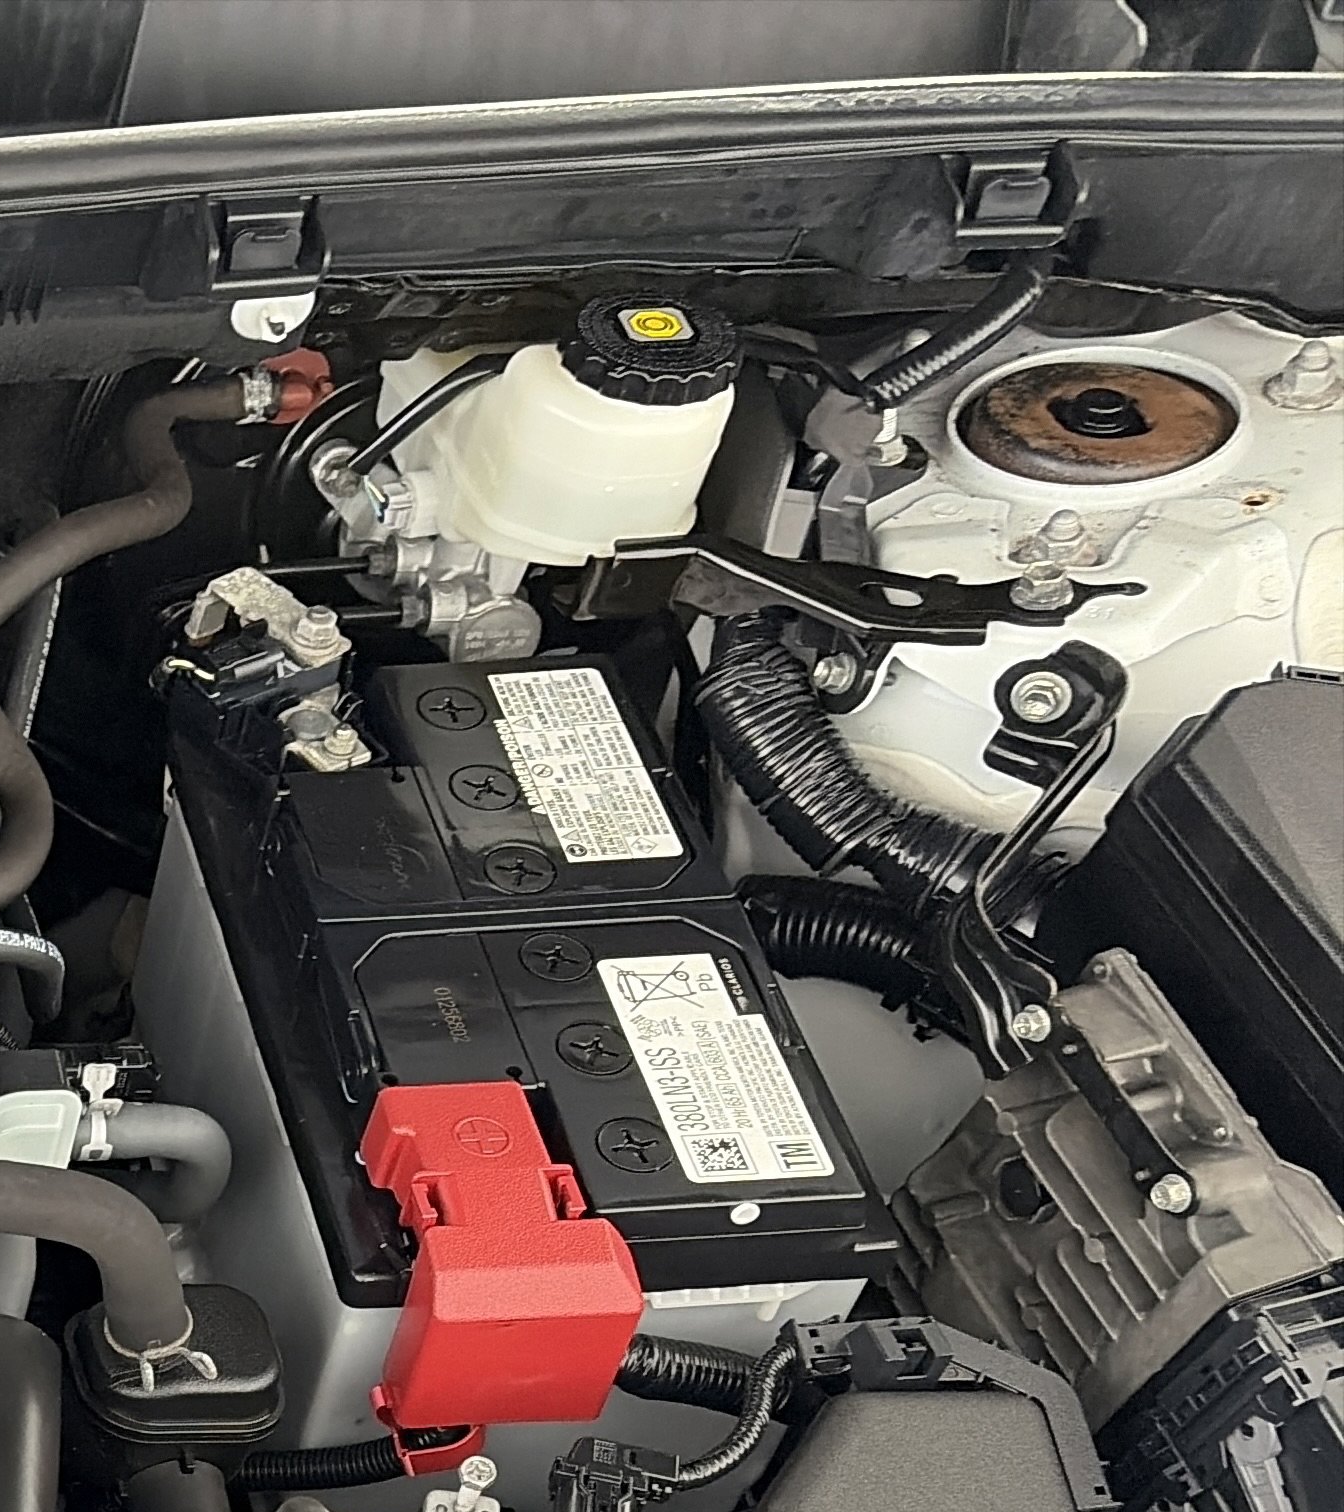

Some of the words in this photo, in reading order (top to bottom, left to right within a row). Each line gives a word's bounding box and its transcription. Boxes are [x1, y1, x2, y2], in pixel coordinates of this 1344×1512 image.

[491, 718, 543, 805] DANGER/POISON
[692, 972, 719, 992] Pb
[715, 956, 745, 996] CLARIOS
[642, 1046, 711, 1132] 380LN3-ISS
[775, 1141, 819, 1169] TM
